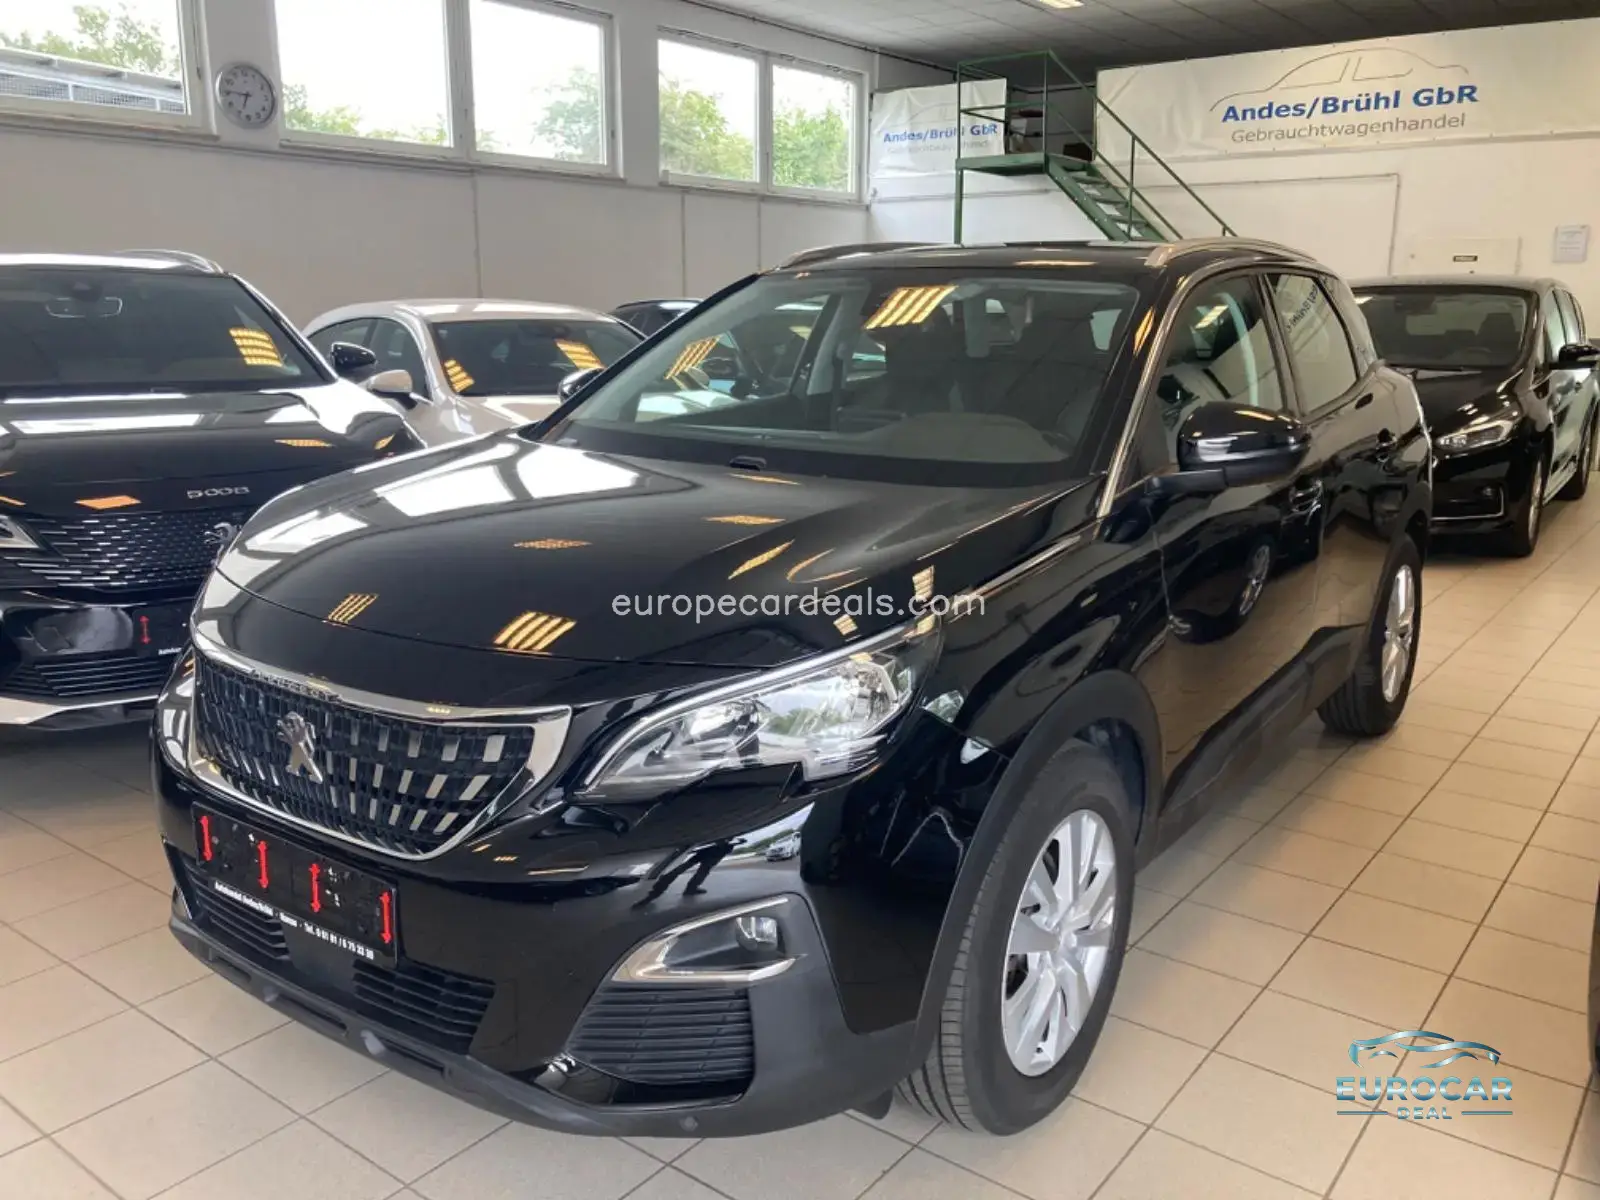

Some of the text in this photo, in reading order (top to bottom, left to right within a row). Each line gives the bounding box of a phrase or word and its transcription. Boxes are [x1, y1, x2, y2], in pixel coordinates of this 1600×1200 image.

[1222, 85, 1479, 123] Andes/Brühl GbR
[970, 122, 998, 136] GbR
[1231, 113, 1466, 143] Gebrauchtwagenhandel
